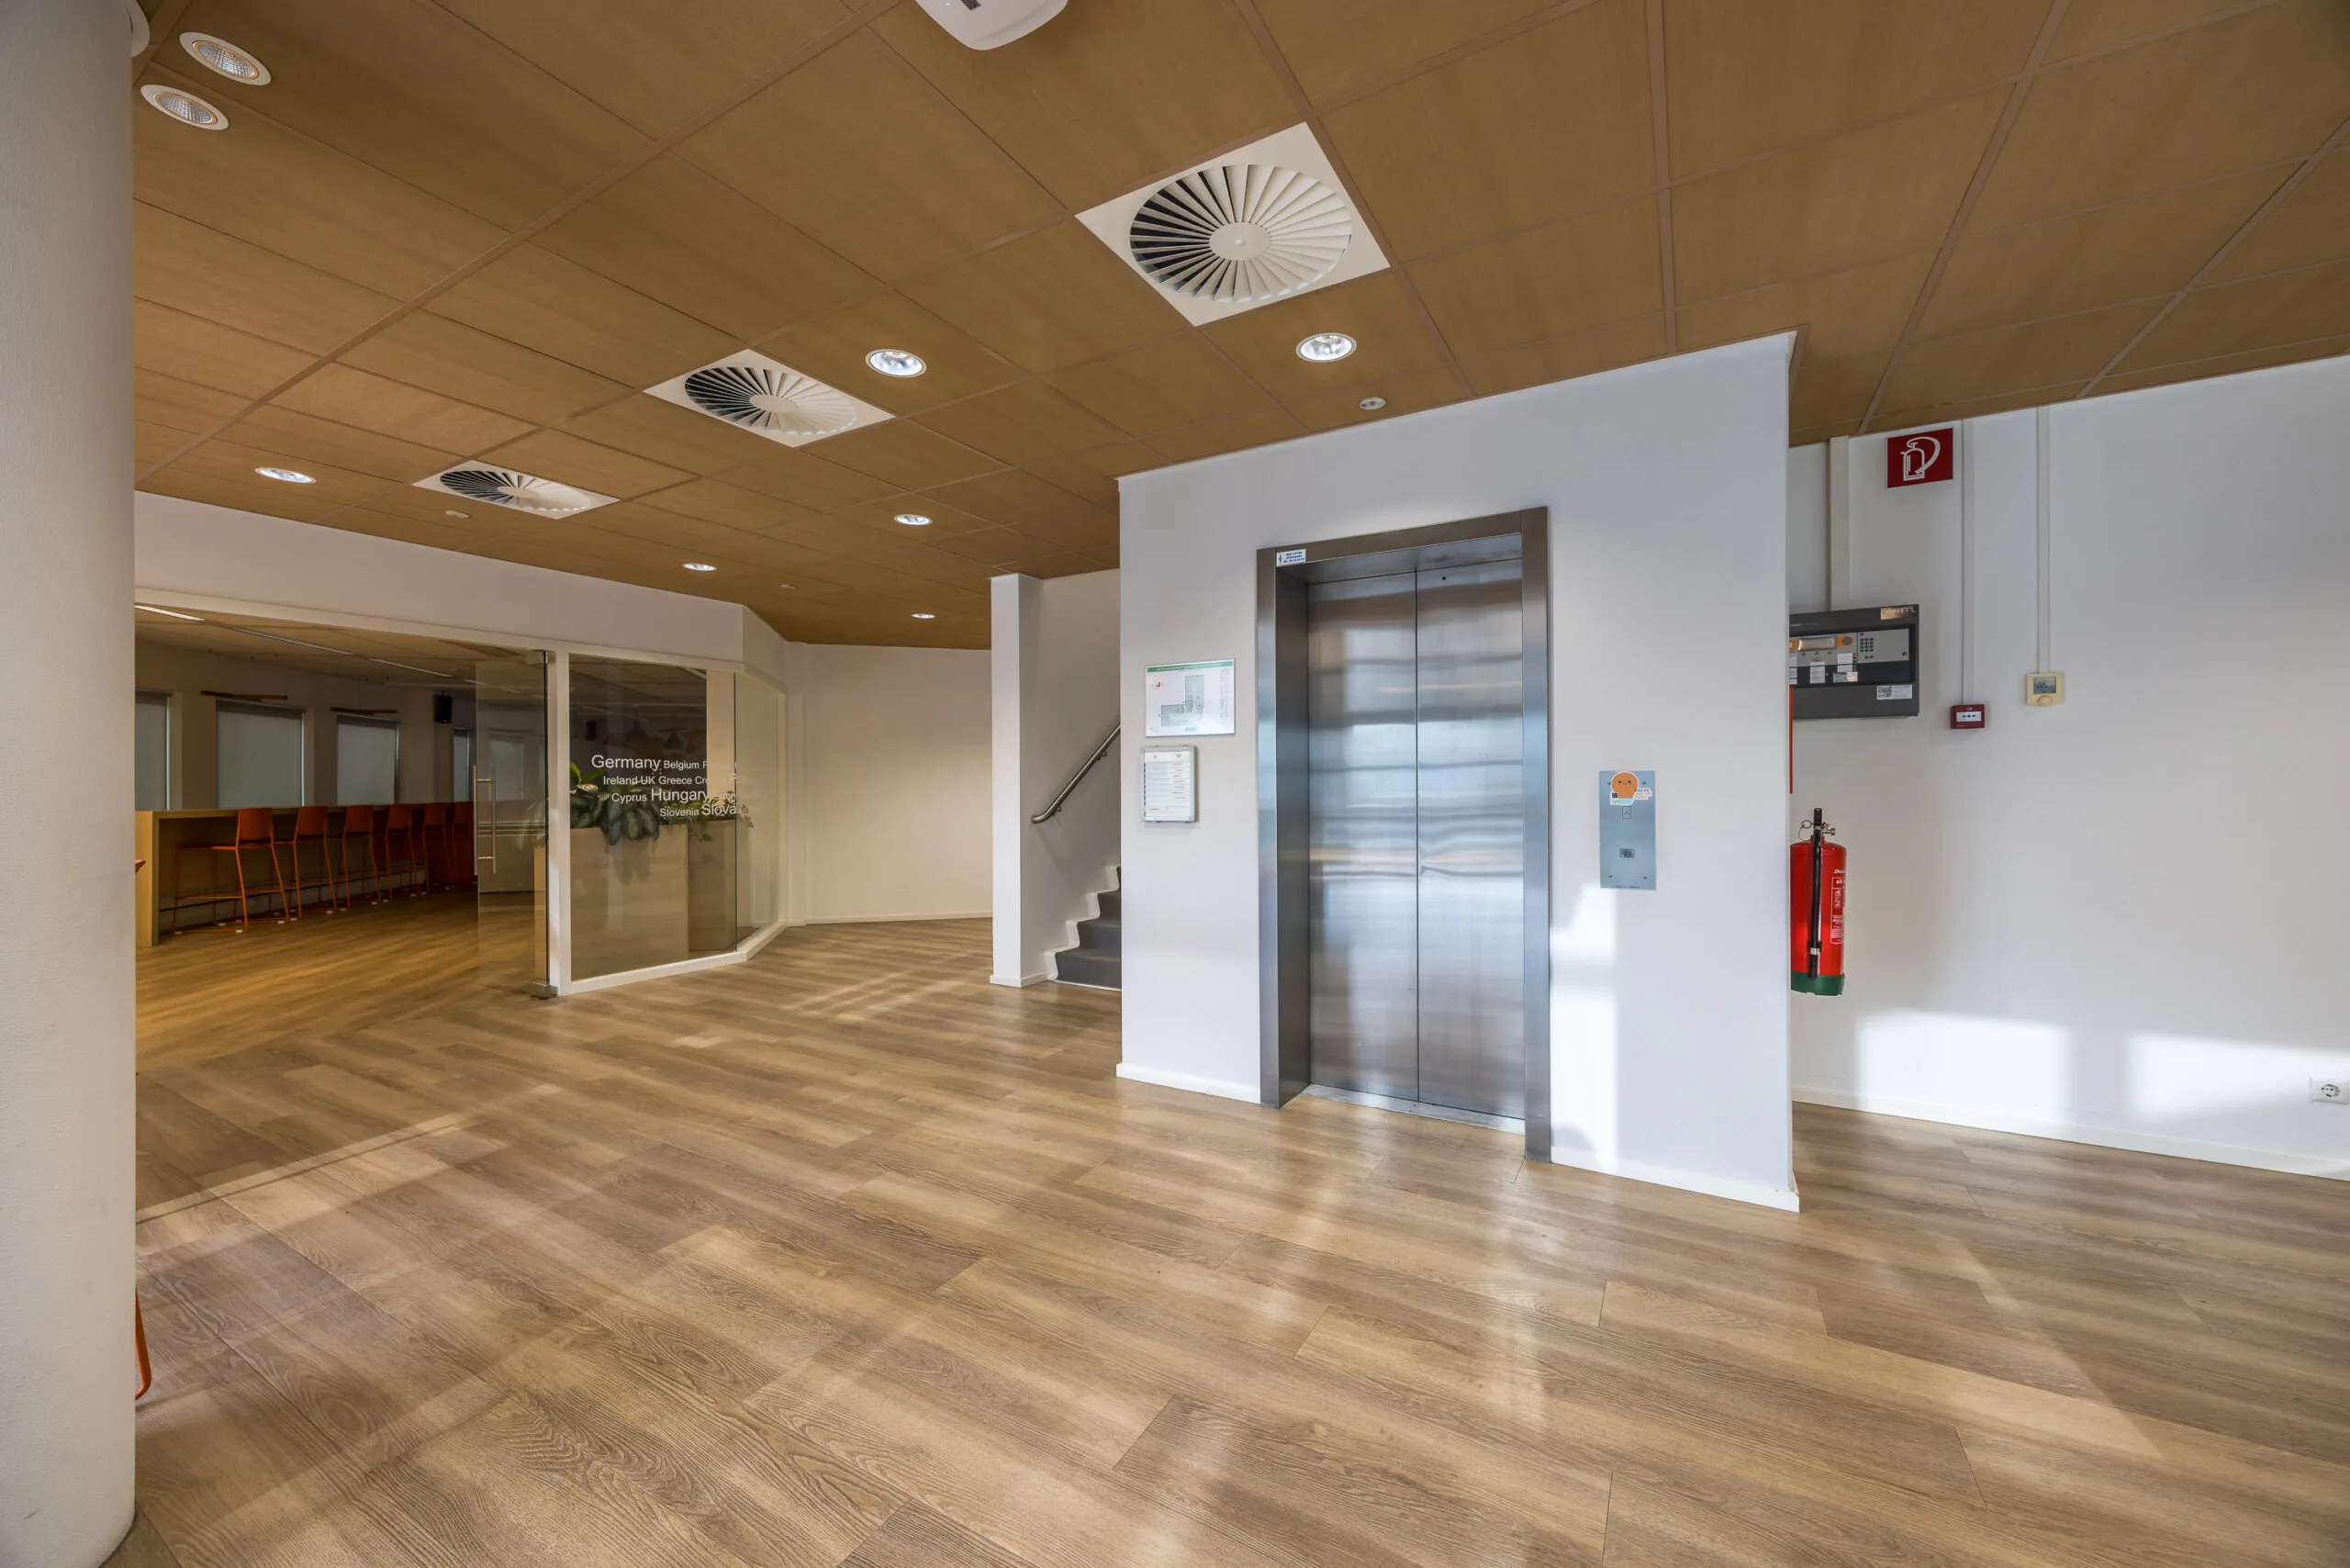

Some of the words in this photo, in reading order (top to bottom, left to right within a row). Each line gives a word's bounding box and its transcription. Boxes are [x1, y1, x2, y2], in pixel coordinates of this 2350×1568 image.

[591, 755, 661, 772] Germany
[664, 760, 699, 770] Belgium
[603, 776, 638, 786] Ireland
[640, 776, 655, 785] UK
[658, 776, 692, 785] Greece
[611, 793, 647, 804] Cyprus
[651, 788, 709, 804] Hungary
[659, 808, 699, 818] Slovenia
